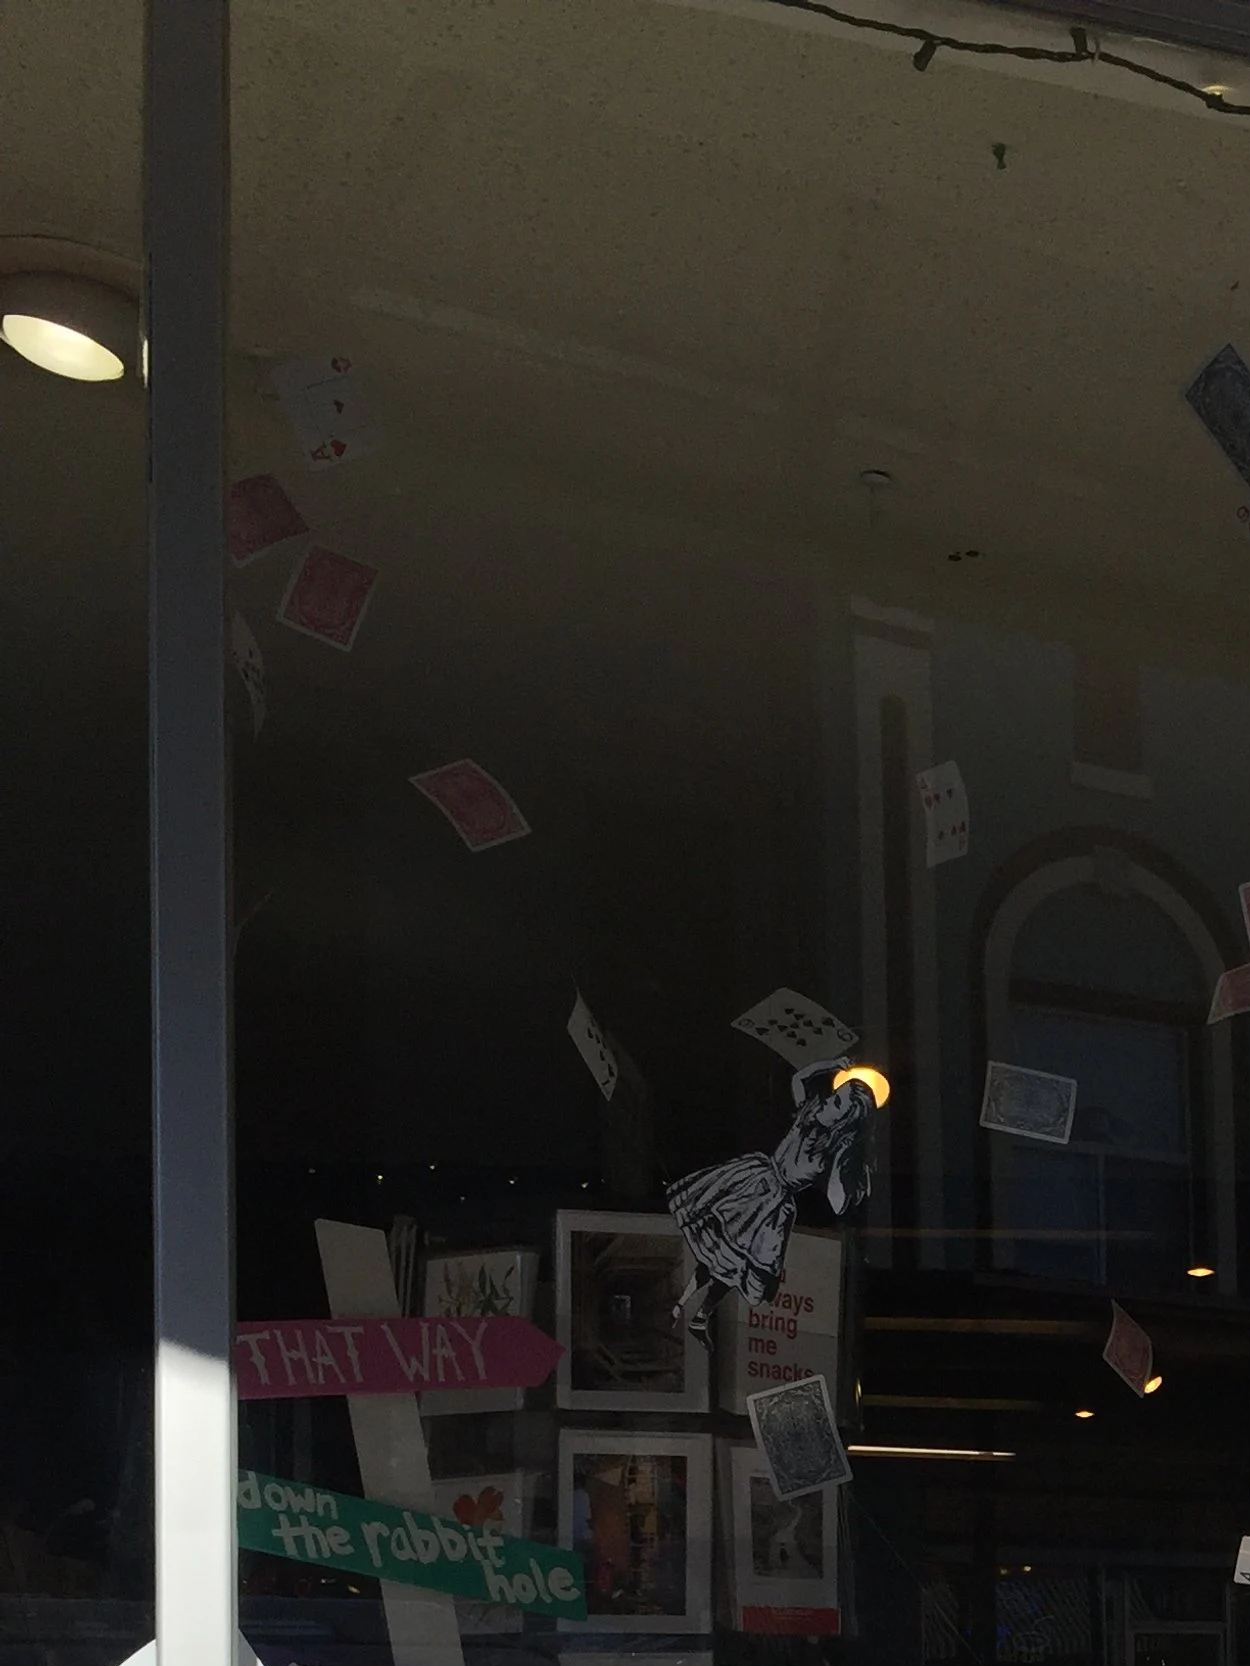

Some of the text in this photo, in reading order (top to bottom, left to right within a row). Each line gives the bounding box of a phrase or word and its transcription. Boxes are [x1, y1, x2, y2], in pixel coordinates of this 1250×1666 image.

[747, 1336, 778, 1356] me
[748, 1309, 798, 1340] bring
[236, 1318, 490, 1387] THAT WAY
[236, 1470, 339, 1519] down
[271, 1512, 507, 1571] the rabbit
[481, 1556, 583, 1607] hole
